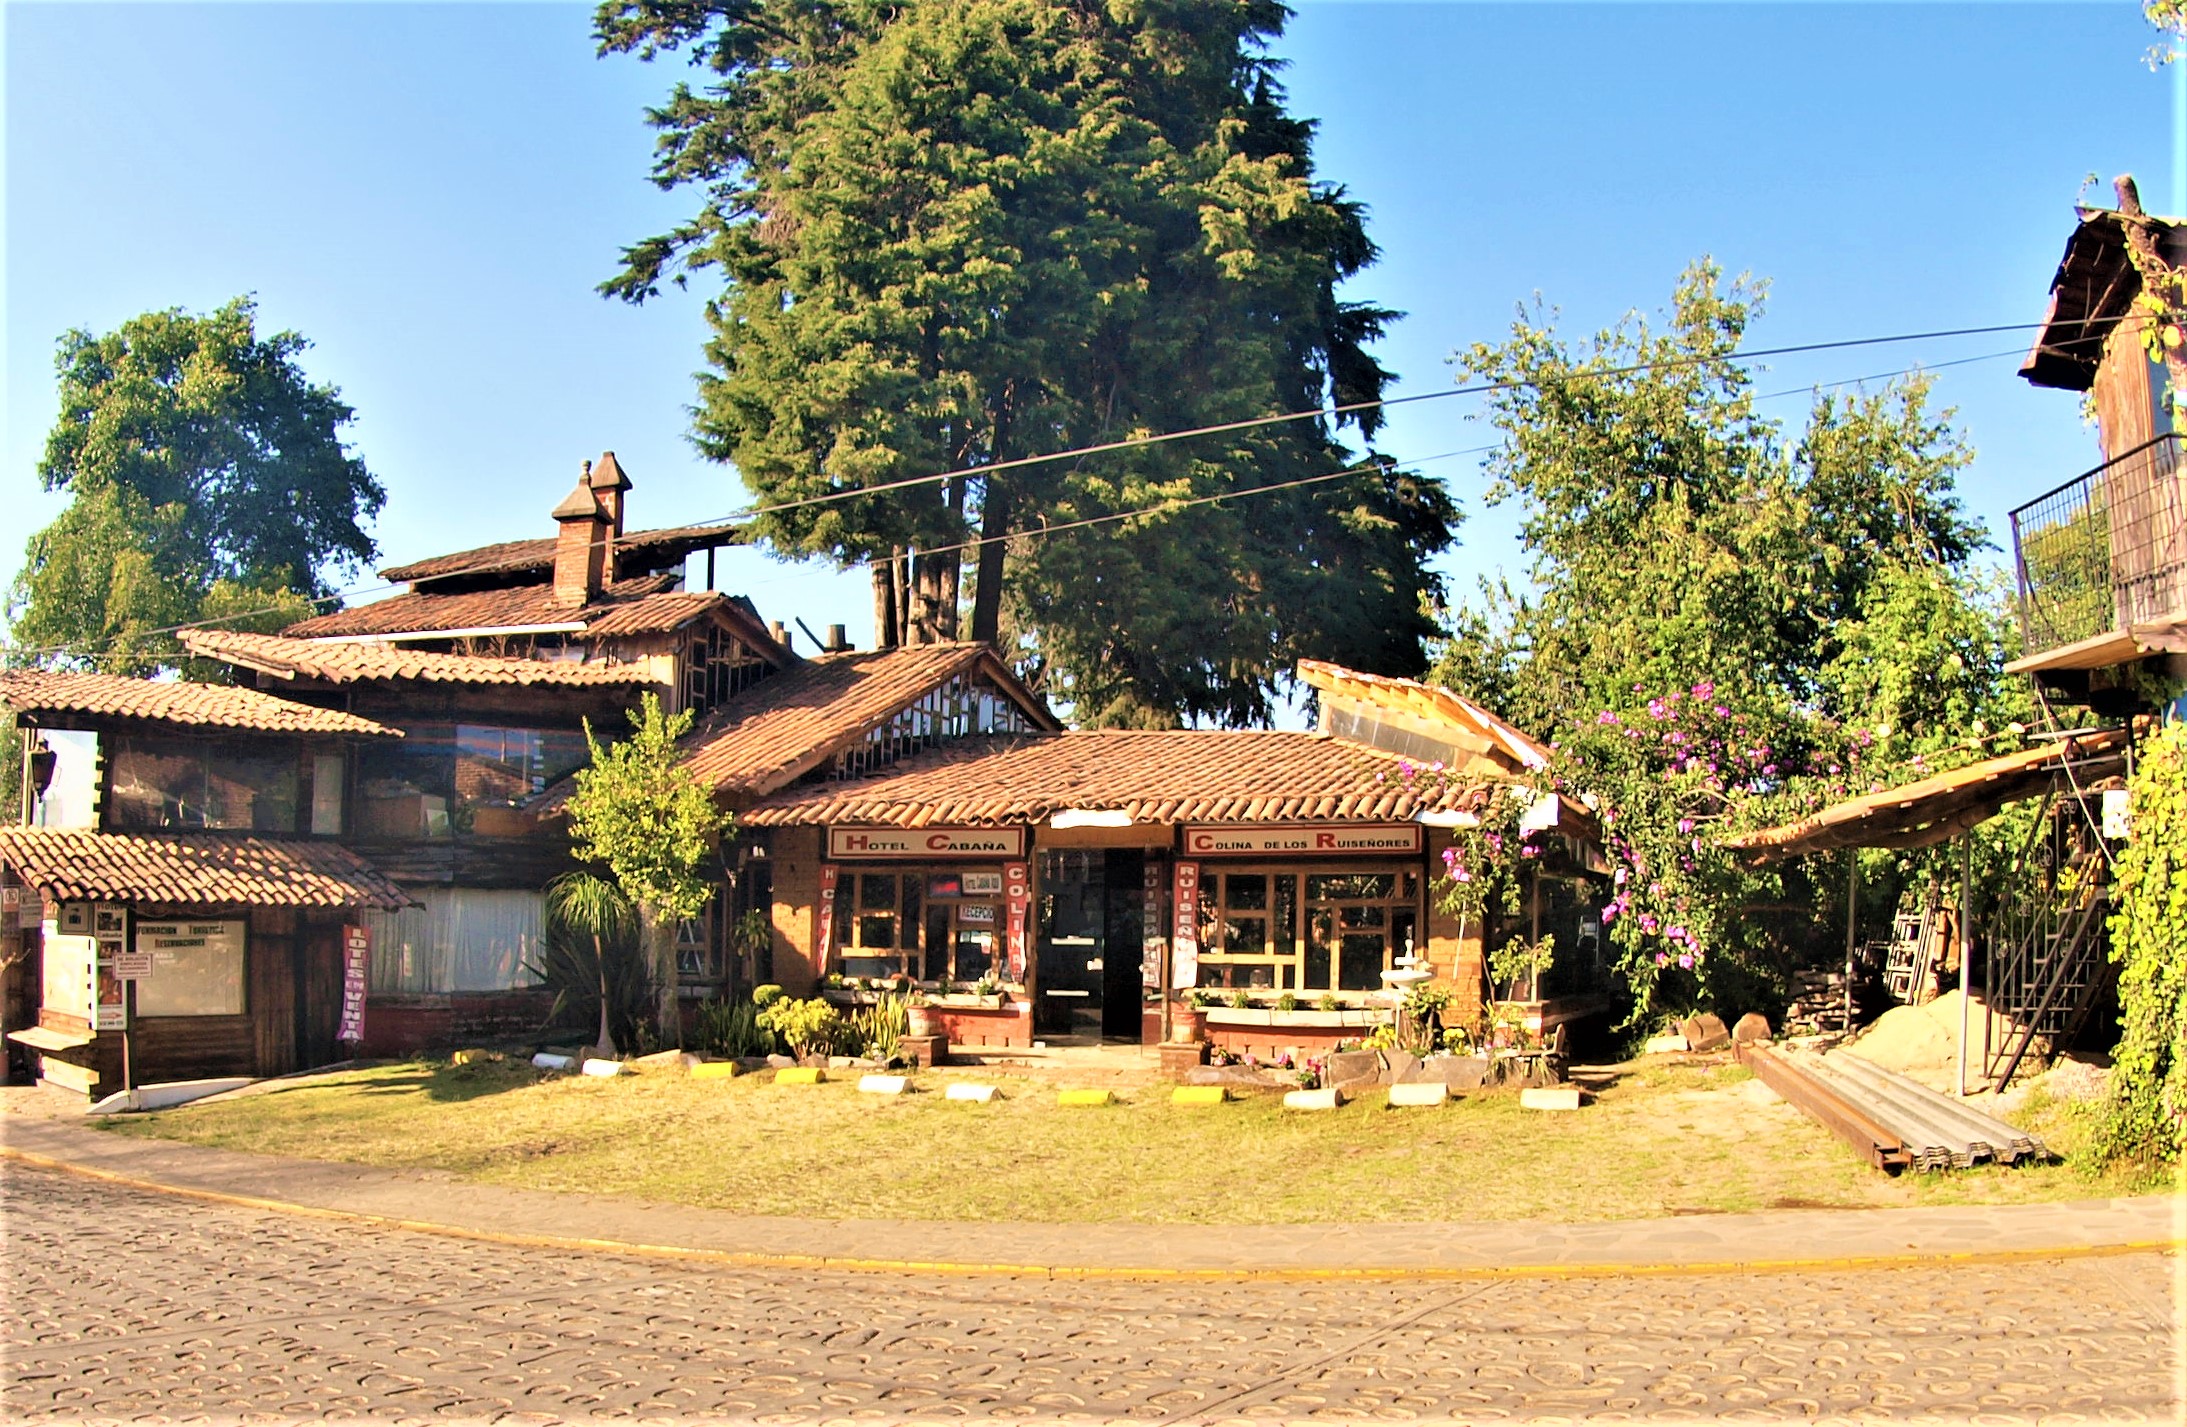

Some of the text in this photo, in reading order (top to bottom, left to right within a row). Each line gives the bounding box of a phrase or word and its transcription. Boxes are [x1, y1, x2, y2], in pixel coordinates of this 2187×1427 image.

[846, 834, 1007, 851] HOTEL CABAÑA
[1194, 833, 1410, 850] COLINA DE LOS RUISEÑORES
[347, 928, 367, 978] LOTES
[341, 991, 363, 1039] VENTA
